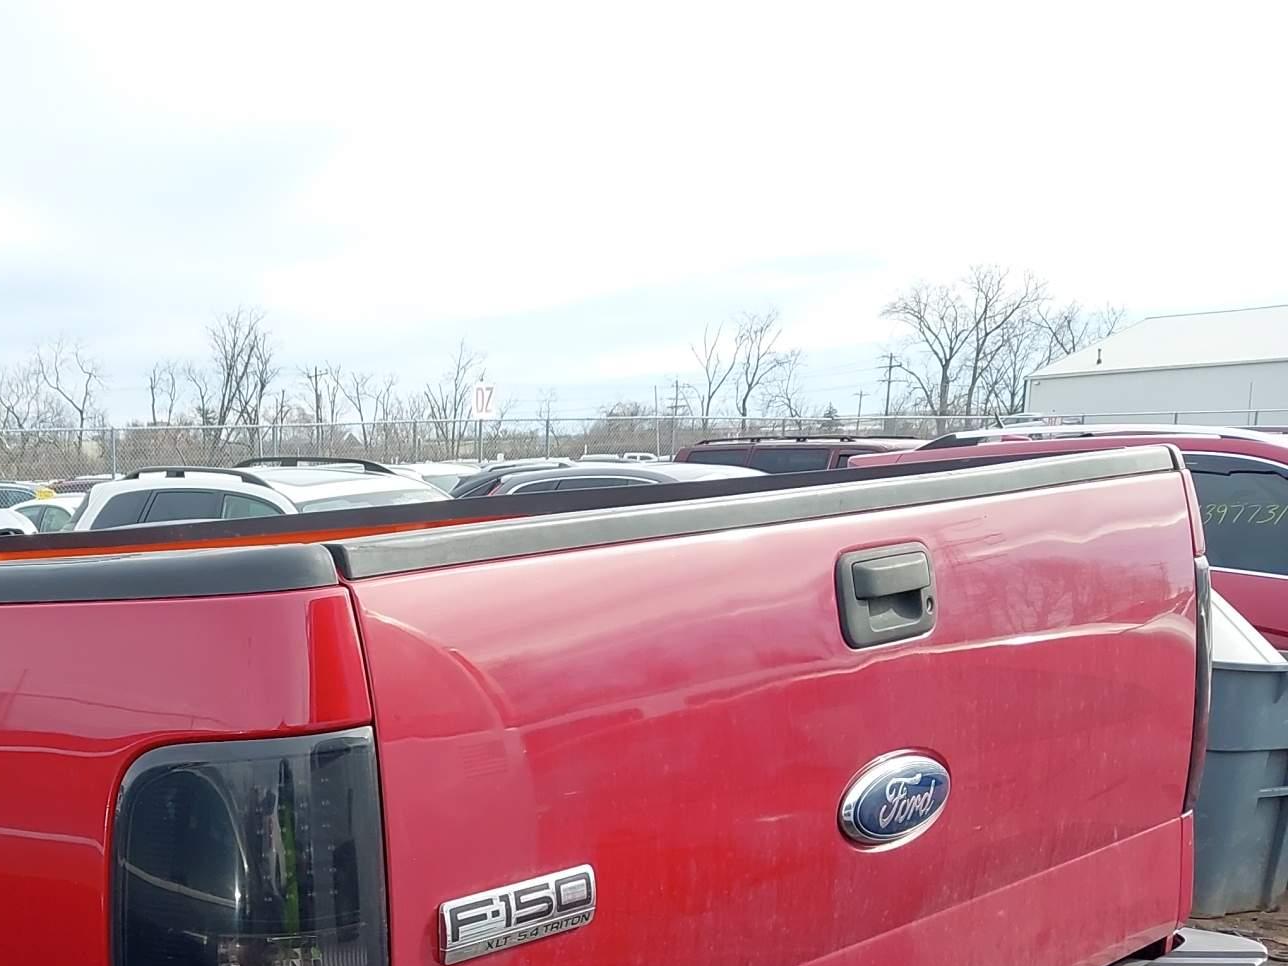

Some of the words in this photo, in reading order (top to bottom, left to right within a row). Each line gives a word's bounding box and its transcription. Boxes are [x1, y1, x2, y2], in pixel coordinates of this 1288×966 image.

[1199, 503, 1288, 525] 397731
[879, 772, 936, 829] Ford
[485, 935, 511, 951] XLT
[543, 912, 592, 934] TRITON
